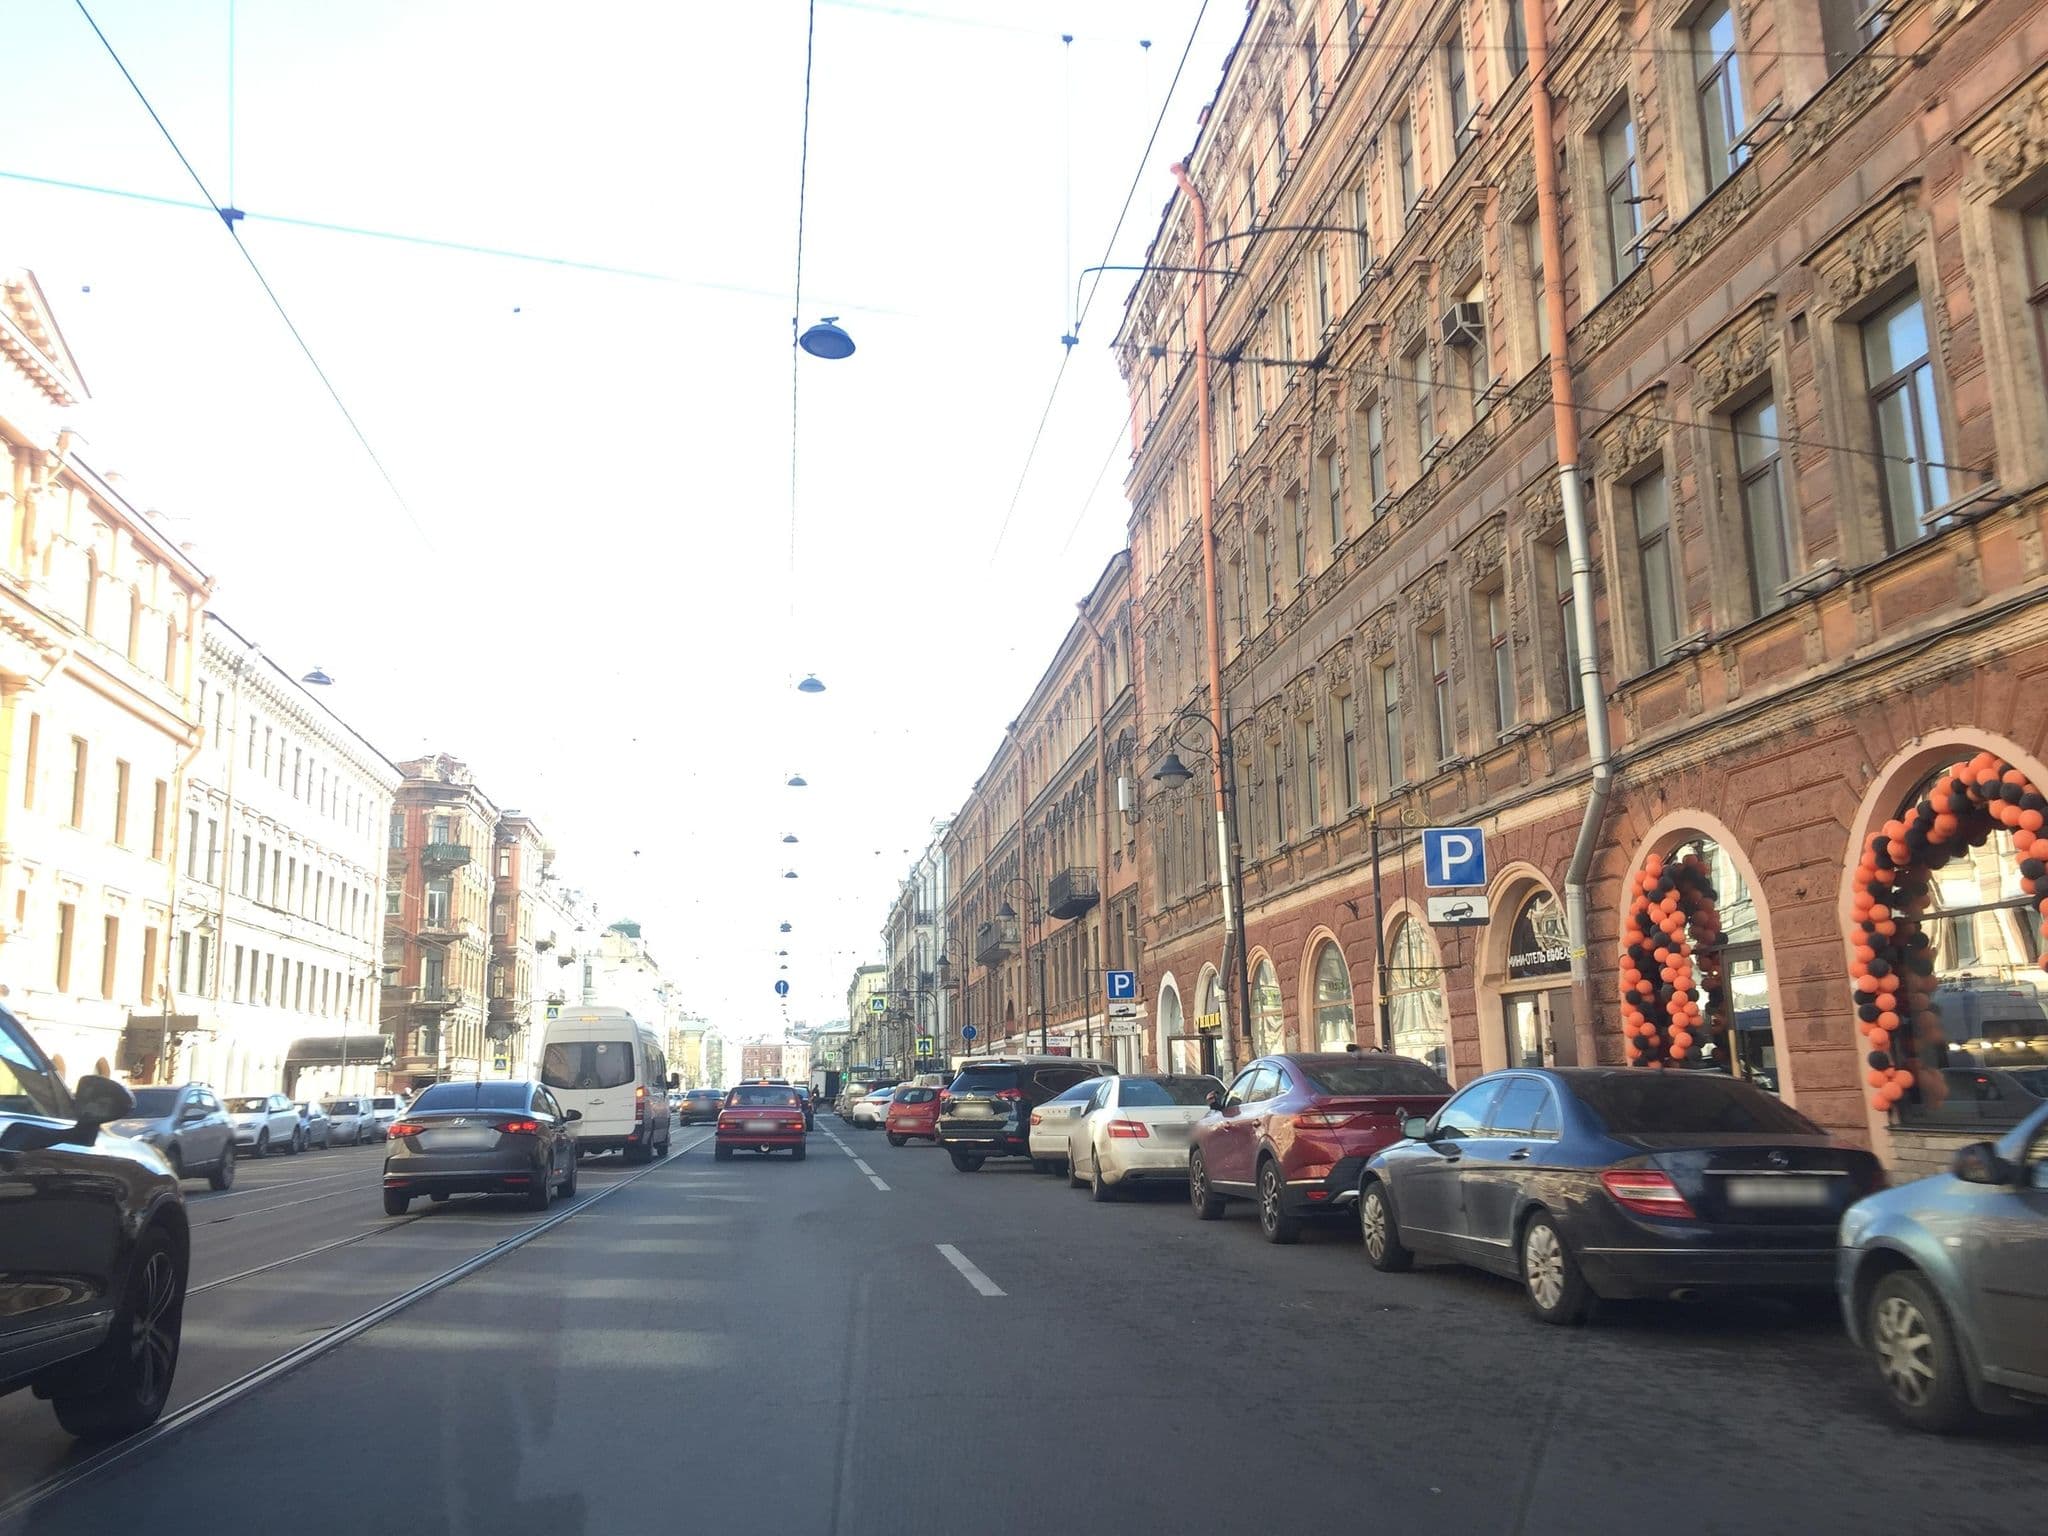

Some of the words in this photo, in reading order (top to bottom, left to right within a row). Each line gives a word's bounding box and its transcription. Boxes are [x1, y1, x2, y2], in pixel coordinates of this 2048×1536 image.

[1441, 835, 1473, 880] P
[1508, 951, 1545, 968] МИНИ-ОТЕЛЬ
[1115, 974, 1130, 996] P
